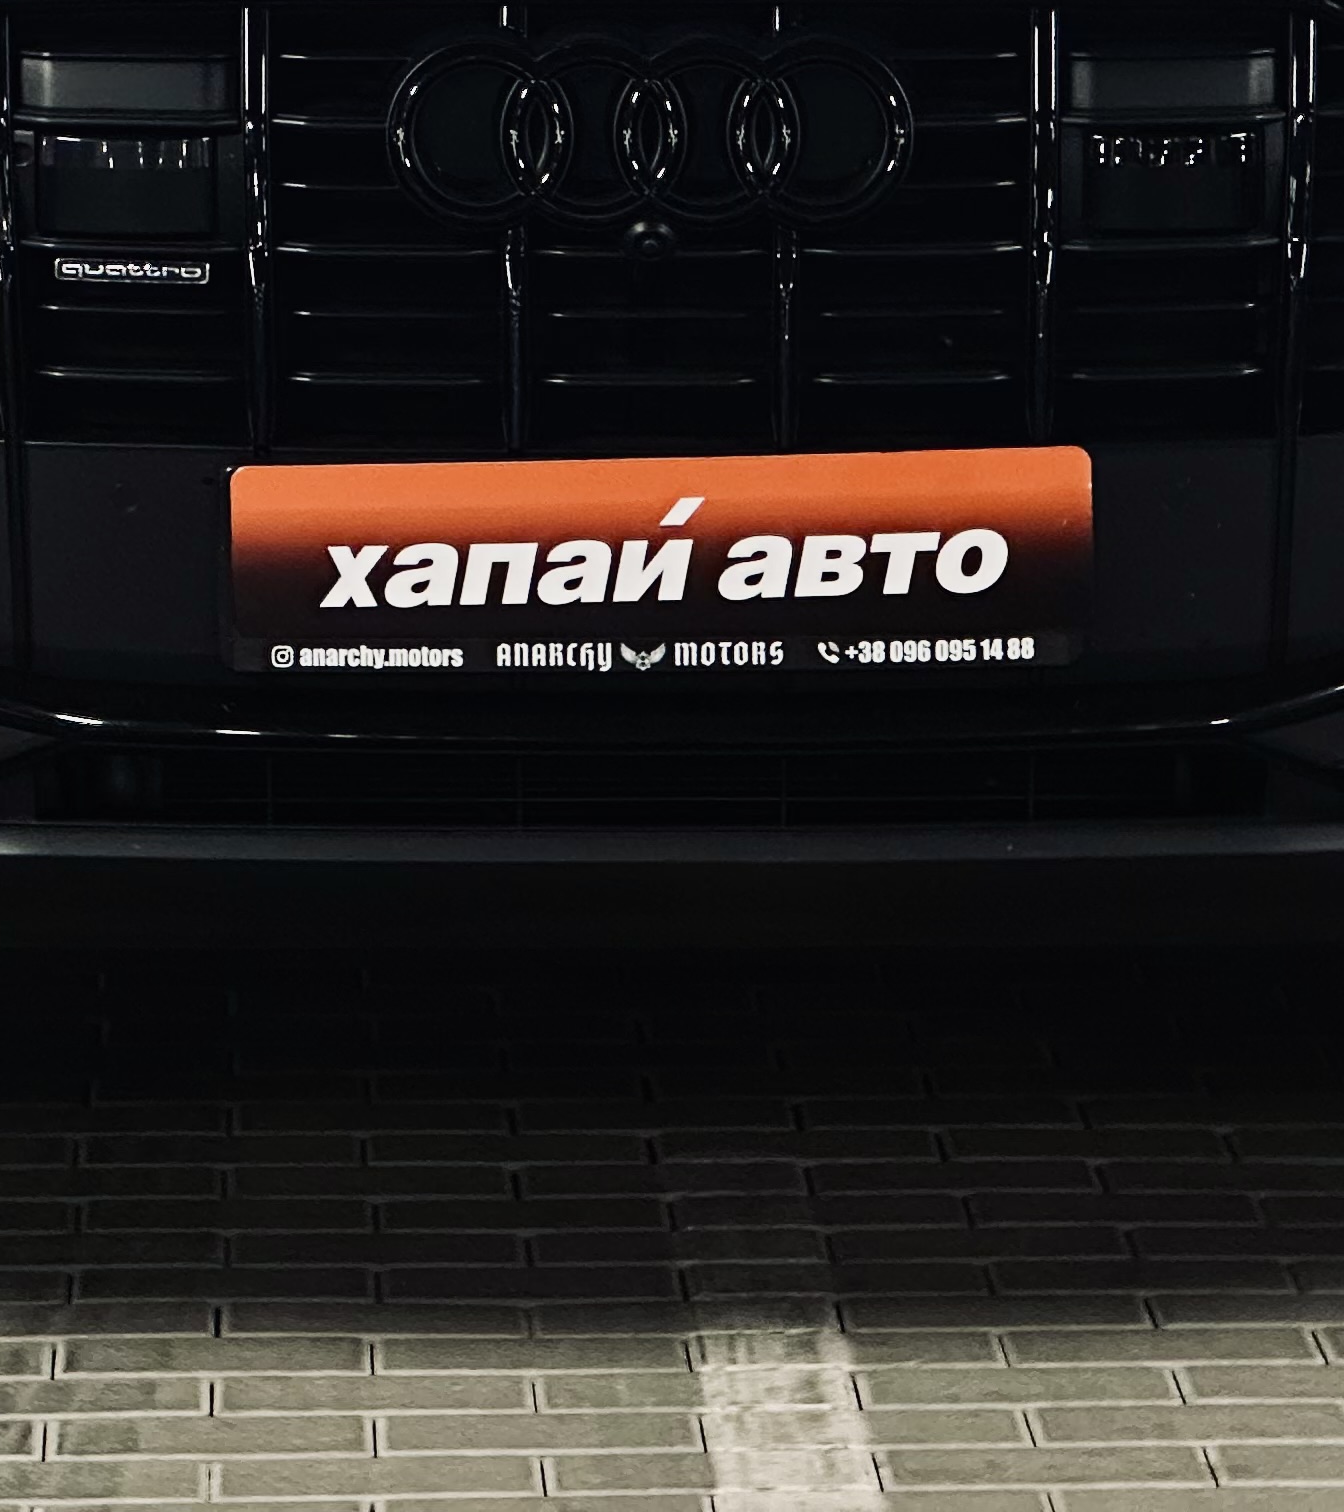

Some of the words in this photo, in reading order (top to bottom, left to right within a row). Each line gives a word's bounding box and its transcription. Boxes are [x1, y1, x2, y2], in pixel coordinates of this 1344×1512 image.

[61, 261, 202, 278] quattro
[717, 528, 1009, 601] авто
[298, 644, 464, 670] anarchy.motors
[844, 640, 886, 664] +38
[889, 639, 932, 663] 096
[934, 638, 977, 663] 095
[979, 638, 1004, 662] 14
[1006, 637, 1035, 661] 88
